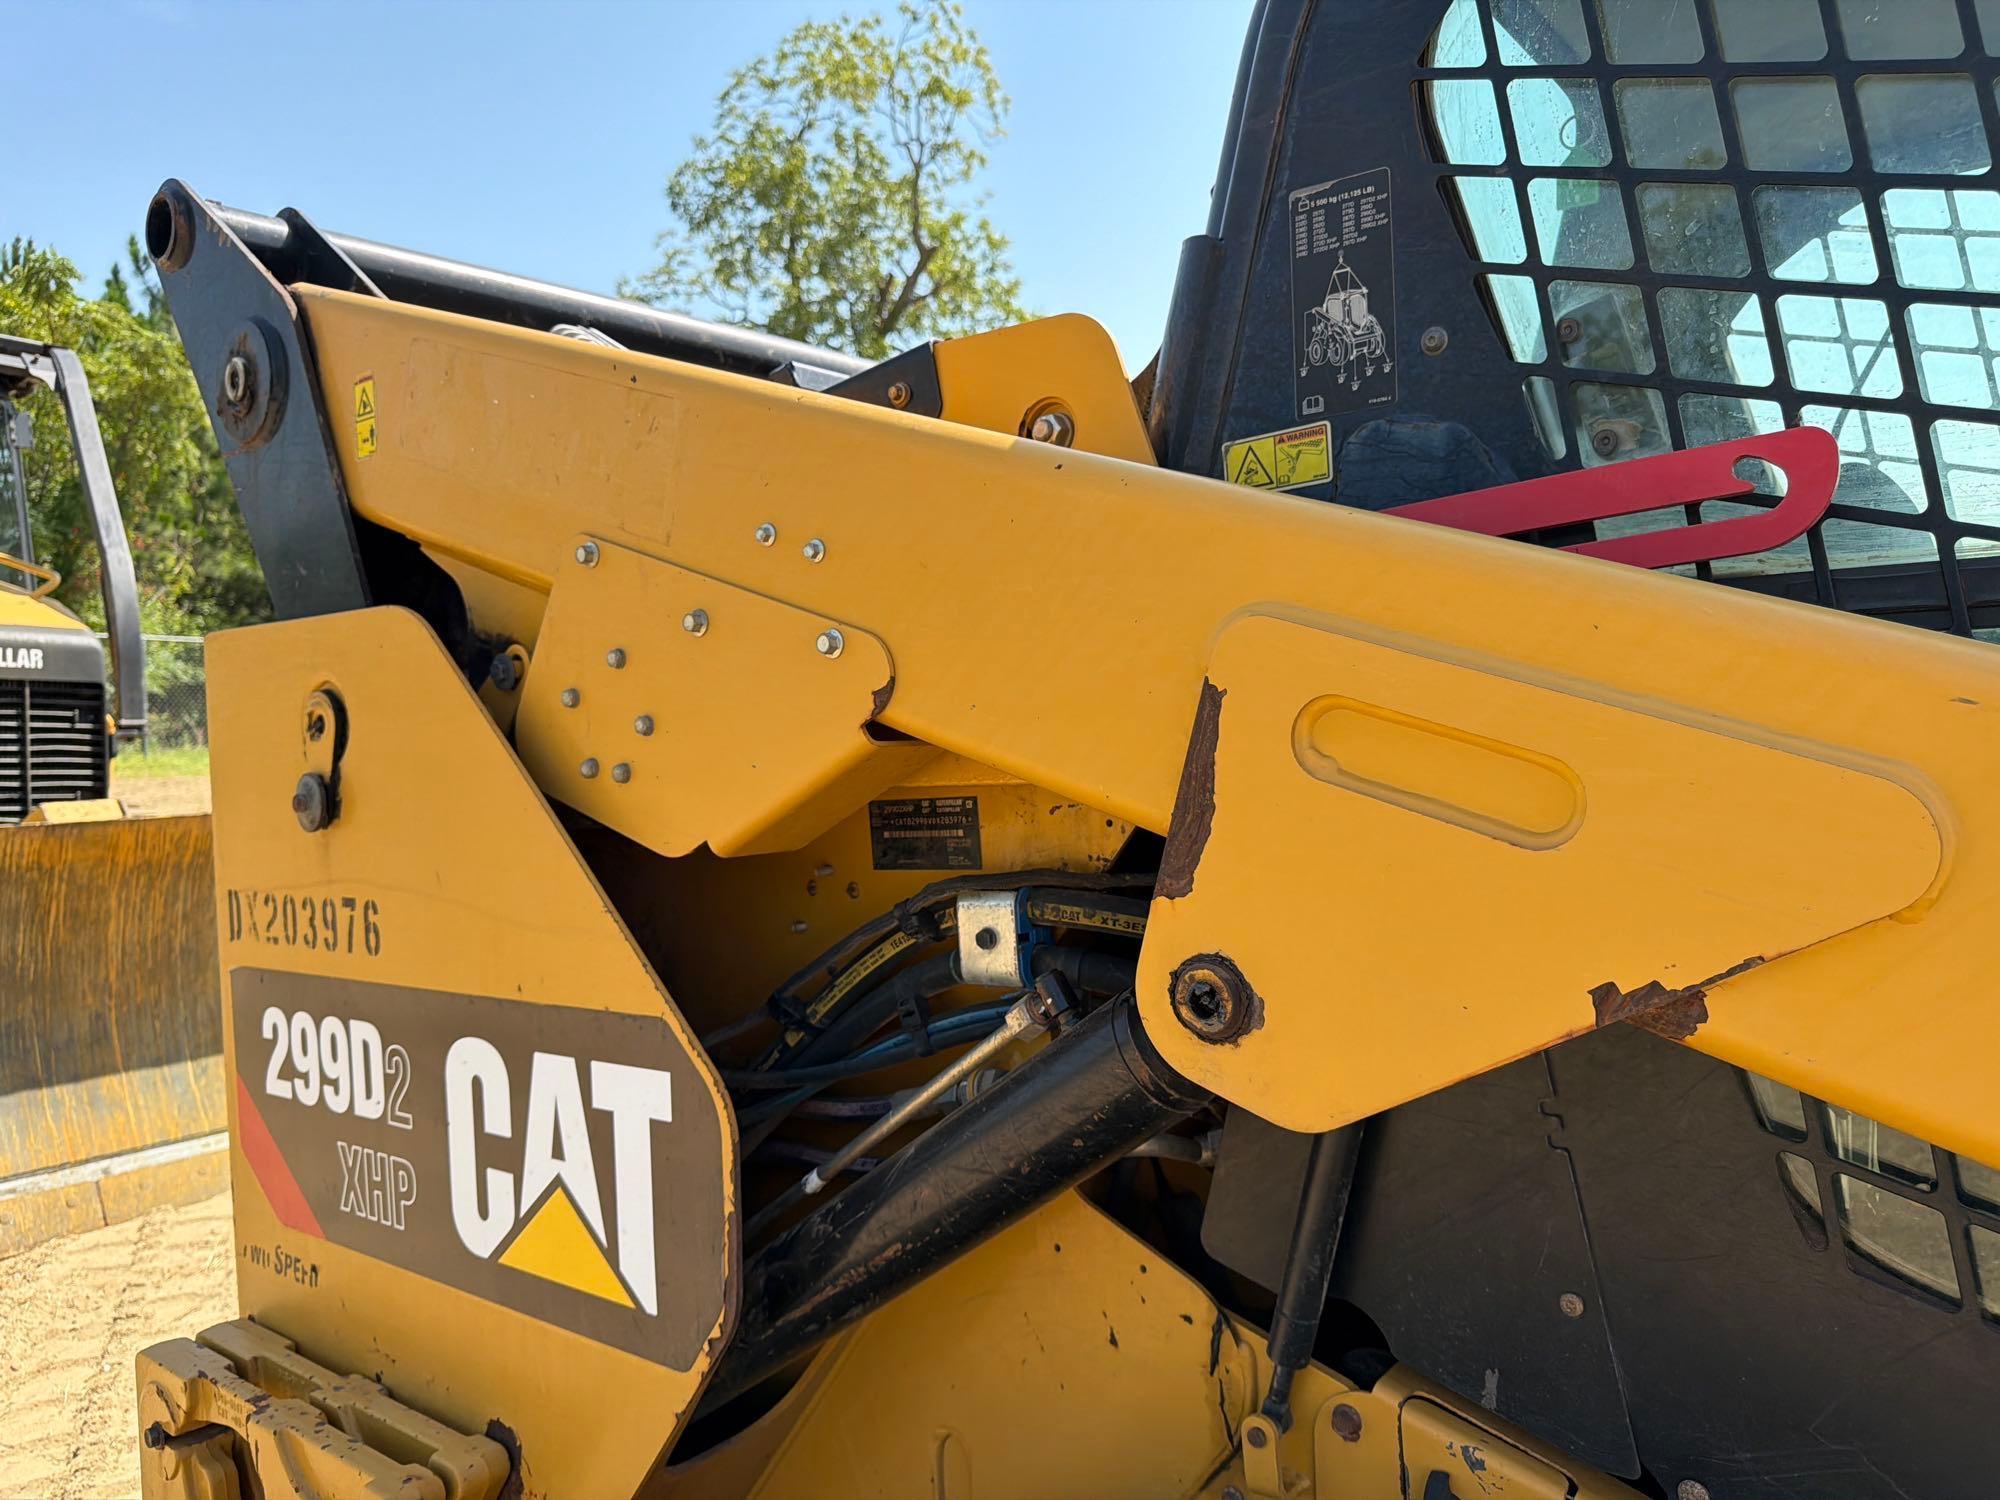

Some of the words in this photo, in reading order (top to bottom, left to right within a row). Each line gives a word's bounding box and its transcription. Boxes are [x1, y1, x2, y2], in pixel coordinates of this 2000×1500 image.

[1316, 199, 1327, 207] 500
[1338, 189, 1361, 201] (12,125
[1286, 427, 1325, 442] WARNING
[228, 889, 381, 957] DX203976
[1061, 909, 1081, 922] CAT
[262, 1006, 414, 1130] 299D2
[336, 1140, 418, 1231] XHP
[445, 1036, 672, 1317] CAT
